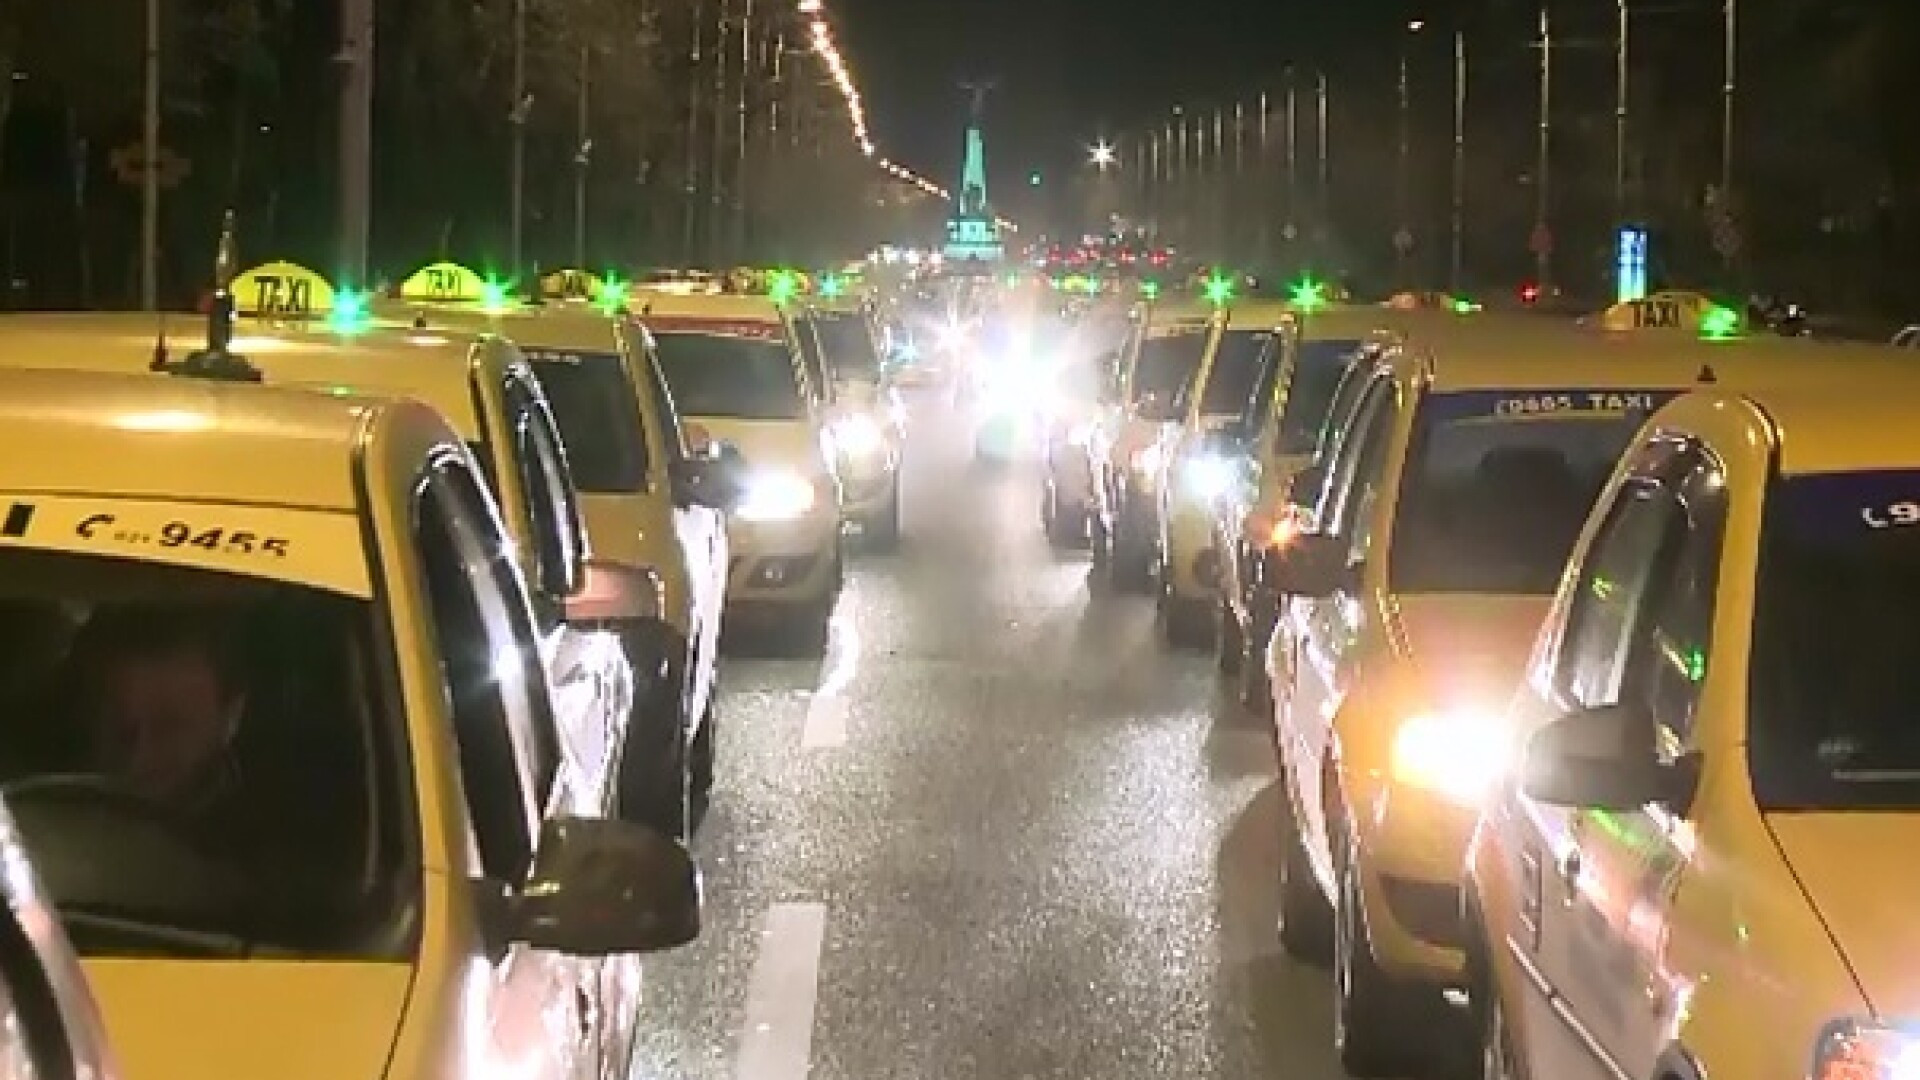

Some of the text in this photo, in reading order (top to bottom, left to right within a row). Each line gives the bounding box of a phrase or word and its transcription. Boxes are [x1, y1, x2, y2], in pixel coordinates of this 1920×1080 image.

[253, 274, 313, 315] TAXI
[425, 268, 463, 299] TAXI
[1630, 300, 1682, 329] TAXI
[1587, 392, 1652, 410] TAXI
